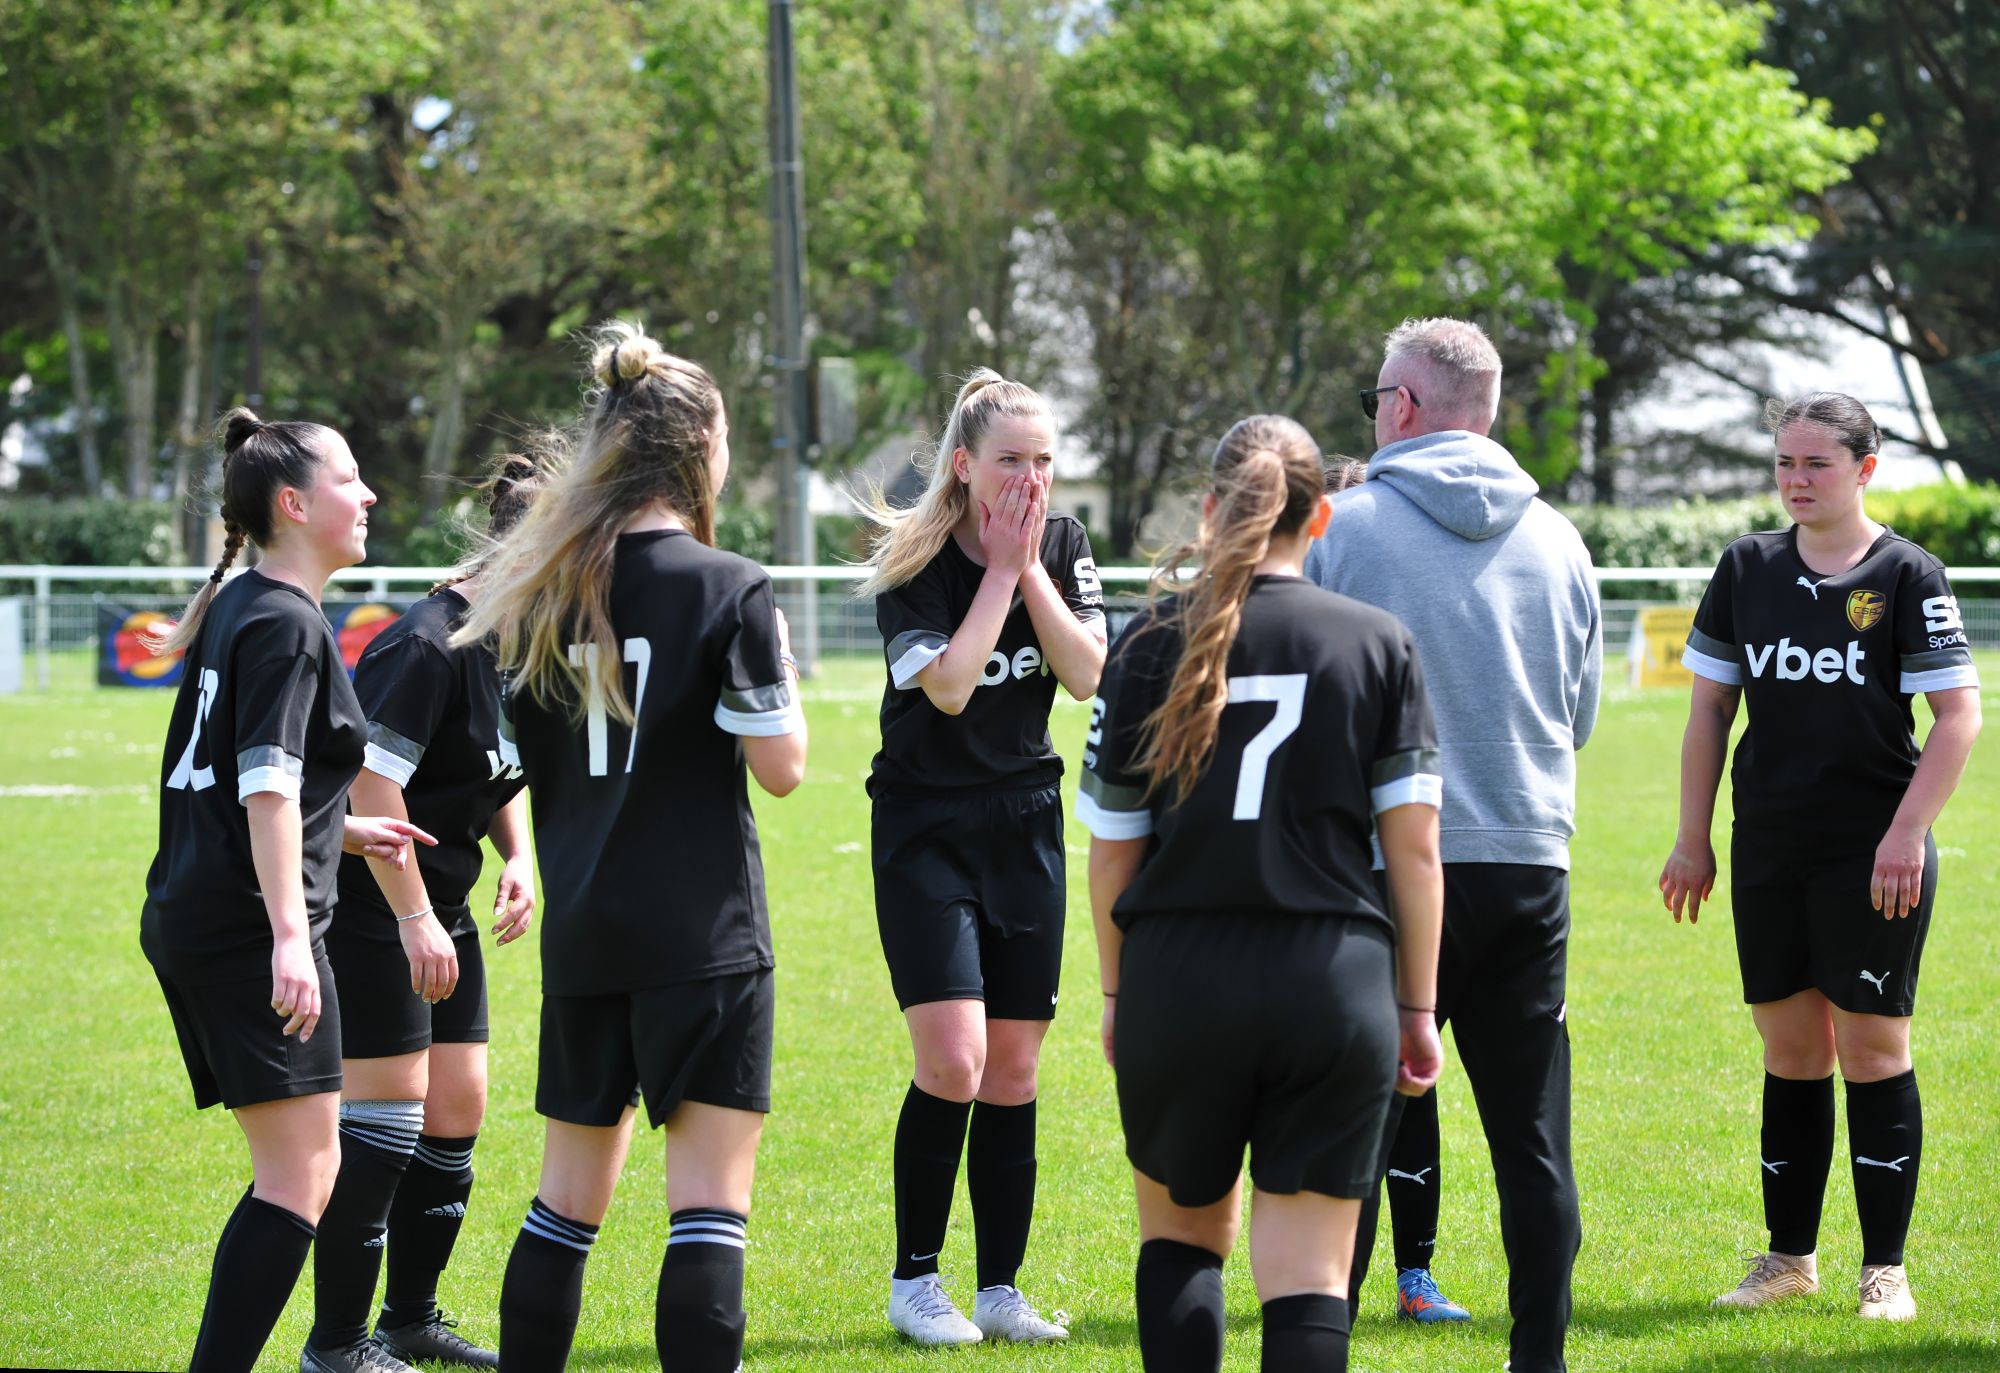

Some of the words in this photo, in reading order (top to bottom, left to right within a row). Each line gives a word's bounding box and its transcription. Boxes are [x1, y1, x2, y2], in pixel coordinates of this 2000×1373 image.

[568, 637, 652, 777] 17
[1744, 637, 1866, 685] vbet
[1227, 673, 1308, 820] 7
